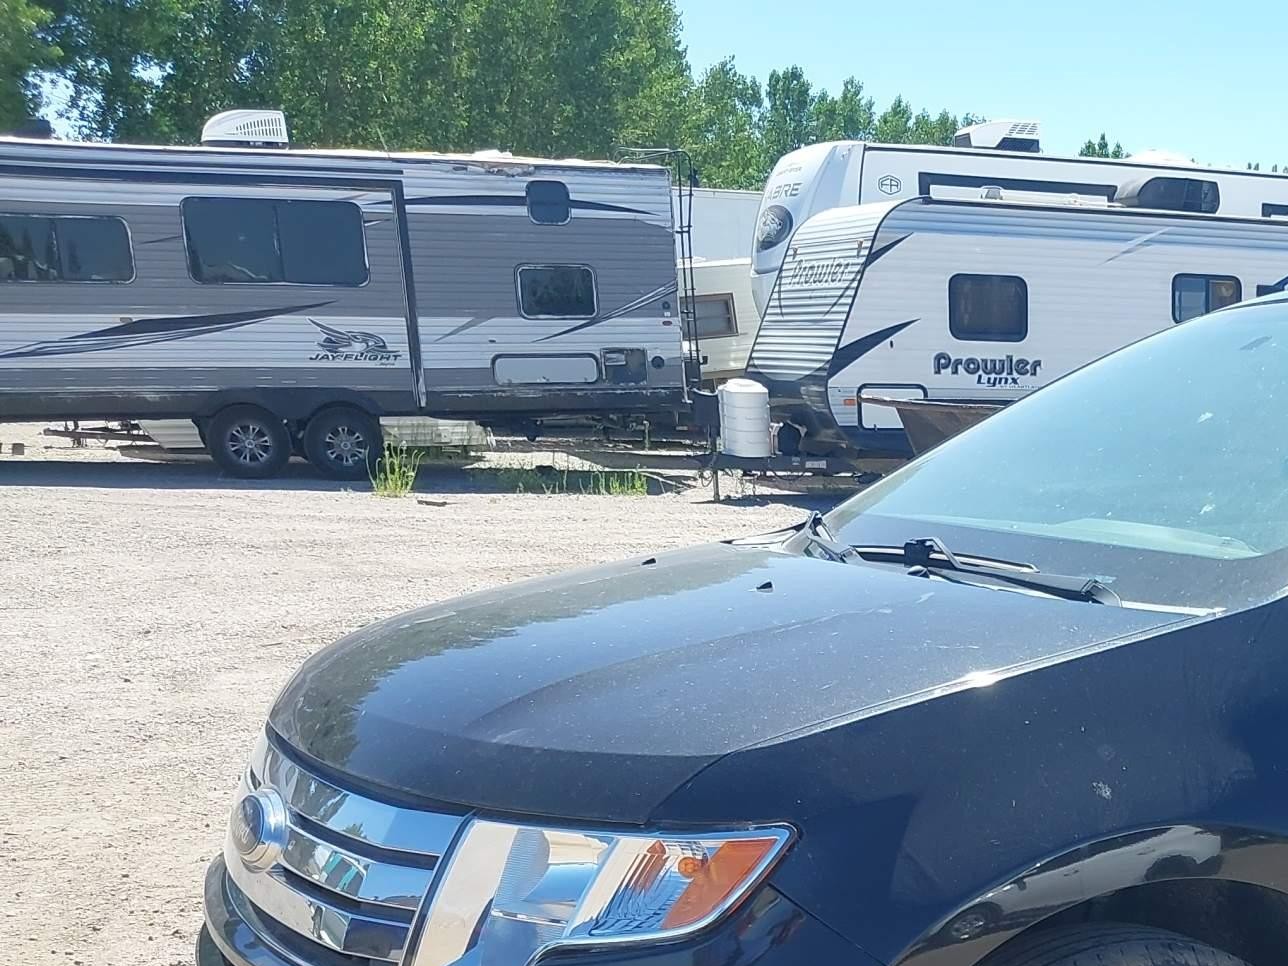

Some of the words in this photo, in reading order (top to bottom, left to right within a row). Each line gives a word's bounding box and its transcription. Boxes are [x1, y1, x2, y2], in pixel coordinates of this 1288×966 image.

[789, 256, 846, 284] Prowler
[933, 351, 1042, 377] Prowler
[976, 374, 1021, 388] Lynx
